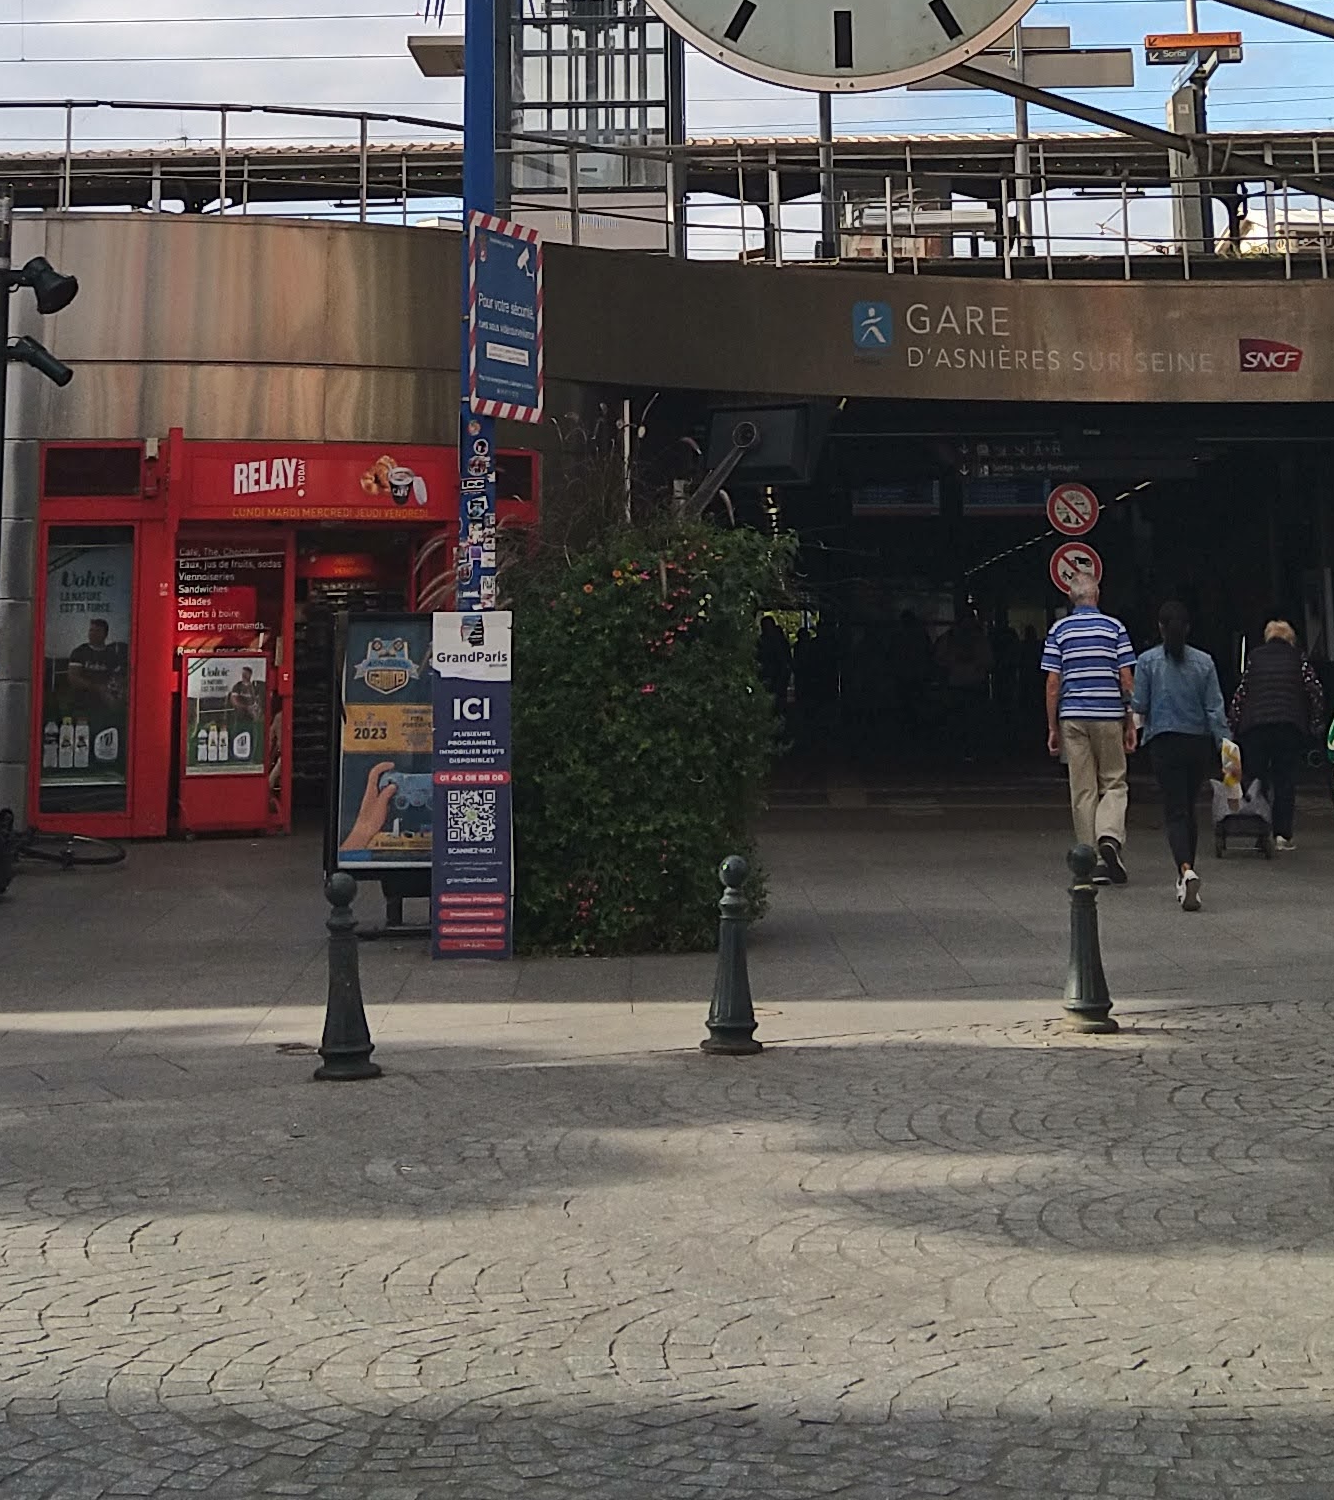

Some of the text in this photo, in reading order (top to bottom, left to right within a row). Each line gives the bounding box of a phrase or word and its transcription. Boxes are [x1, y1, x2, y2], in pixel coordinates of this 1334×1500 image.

[478, 292, 494, 308] Pour
[494, 299, 510, 314] votre
[905, 303, 1010, 336] GARE
[907, 344, 1213, 373] D'ASNIÈRES SUR SEINE
[1242, 350, 1299, 370] SNCF
[233, 458, 297, 494] RELAY
[297, 458, 306, 486] TODAY
[232, 508, 264, 518] LUNDI
[266, 508, 300, 518] MARDI
[302, 508, 353, 518] MERCREDI
[355, 508, 382, 518] JEUDI
[179, 560, 202, 570] Eaux,
[204, 561, 216, 571] jus
[218, 560, 229, 569] de
[61, 570, 115, 588] Volvic
[178, 572, 235, 581] Viennoiseries
[178, 585, 228, 594] Sandwiches
[178, 596, 212, 606] Salades
[177, 608, 240, 619] Yaourts à boire
[177, 621, 215, 631] Desserts
[436, 651, 507, 663] GrandParis
[453, 697, 490, 721] ICI
[354, 727, 387, 740] 2023
[446, 877, 498, 885] grandparis.com
